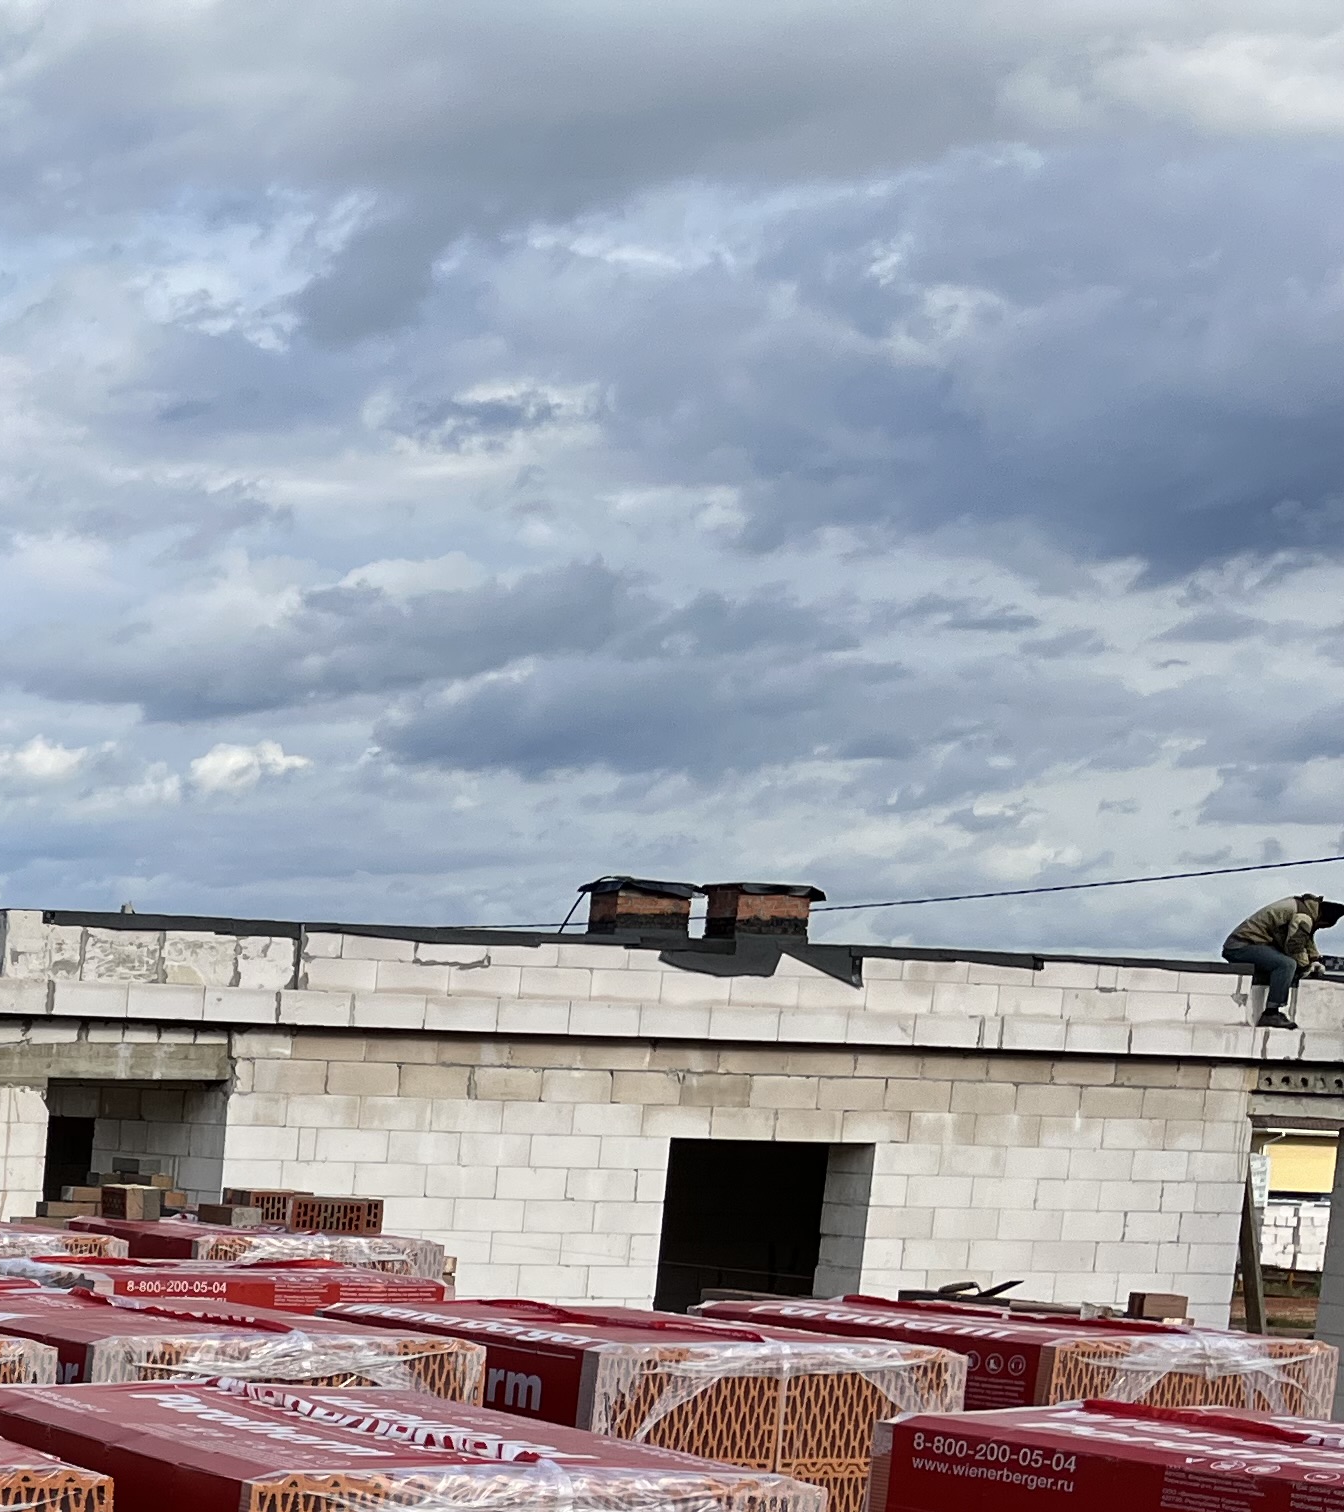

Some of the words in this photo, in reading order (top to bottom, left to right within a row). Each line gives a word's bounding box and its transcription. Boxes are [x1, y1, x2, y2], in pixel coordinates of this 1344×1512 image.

[127, 1279, 227, 1294] 8-800-200-05-04
[913, 1432, 1077, 1473] 8-800-200-05-04
[912, 1456, 1074, 1493] www.wienerberger.ru
